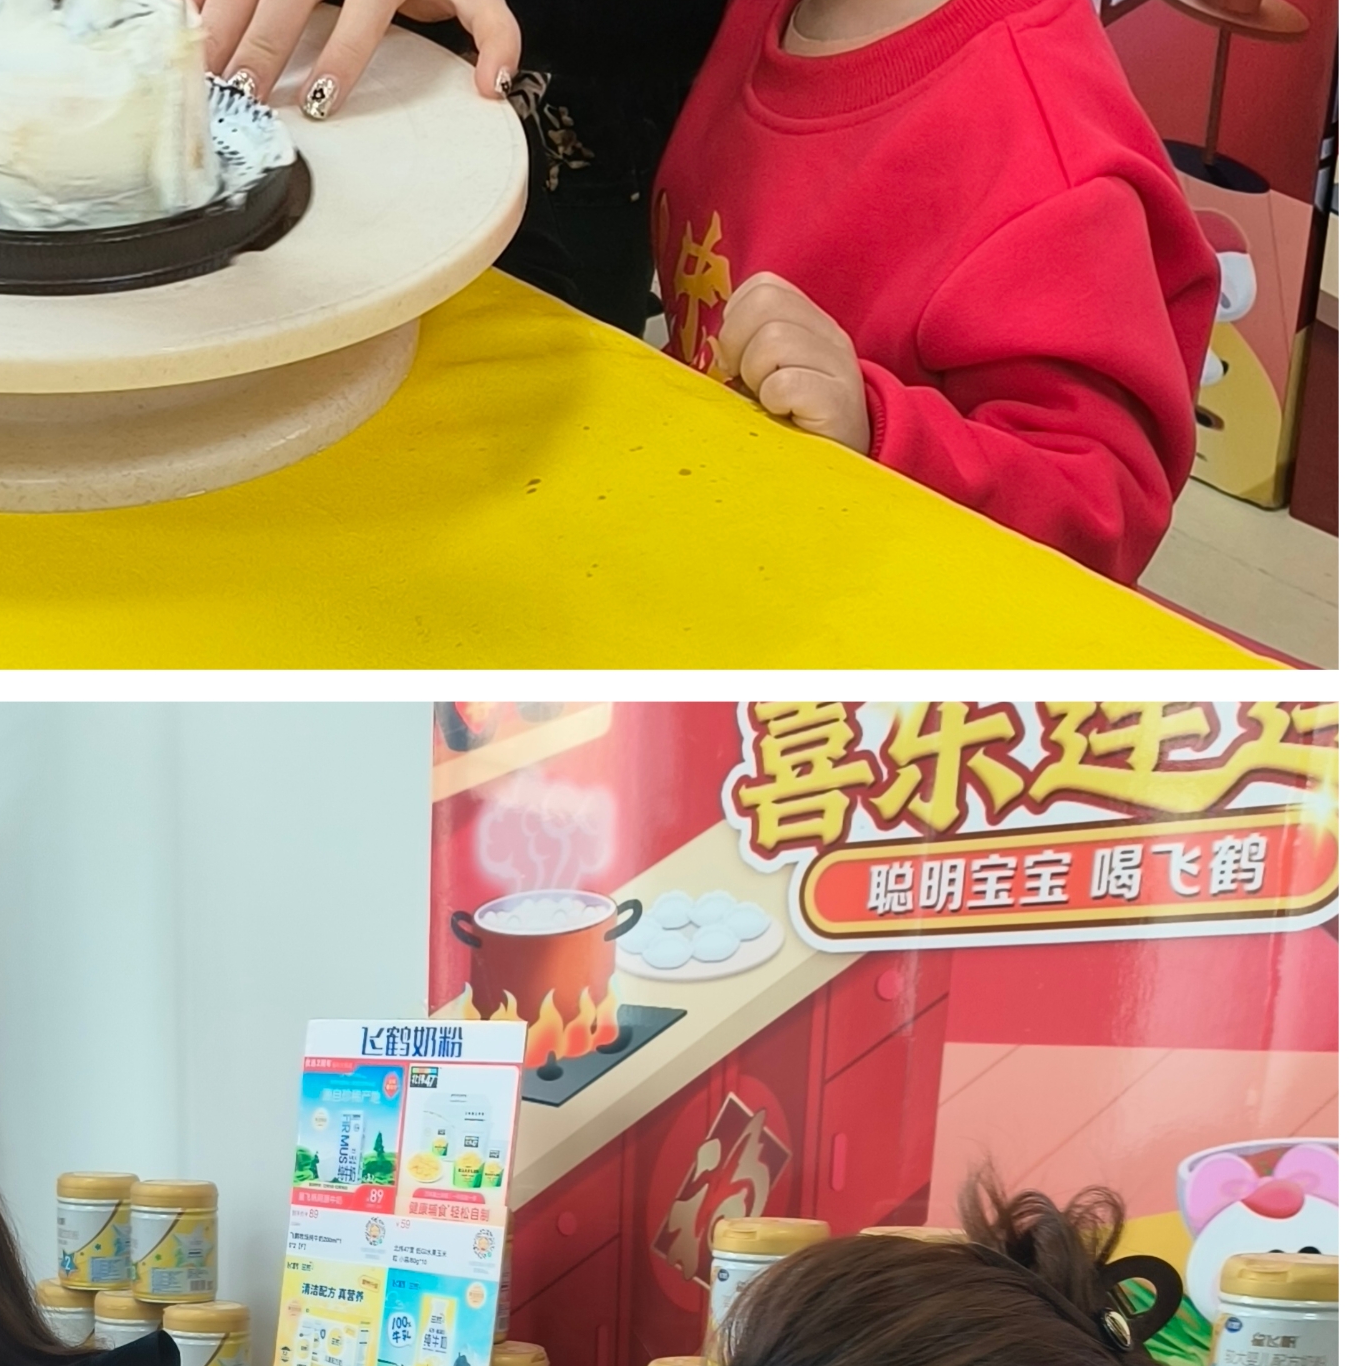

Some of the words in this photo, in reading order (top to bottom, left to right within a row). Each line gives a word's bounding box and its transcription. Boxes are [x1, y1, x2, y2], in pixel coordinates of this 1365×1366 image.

[867, 849, 1073, 916] 聪明宝宝
[1090, 833, 1269, 901] 喝飞鹤
[361, 1025, 464, 1059] 飞鹤奶粉
[338, 1113, 353, 1165] FIRMUS
[301, 1283, 336, 1299] 清洁配方
[337, 1287, 364, 1303] 真营养
